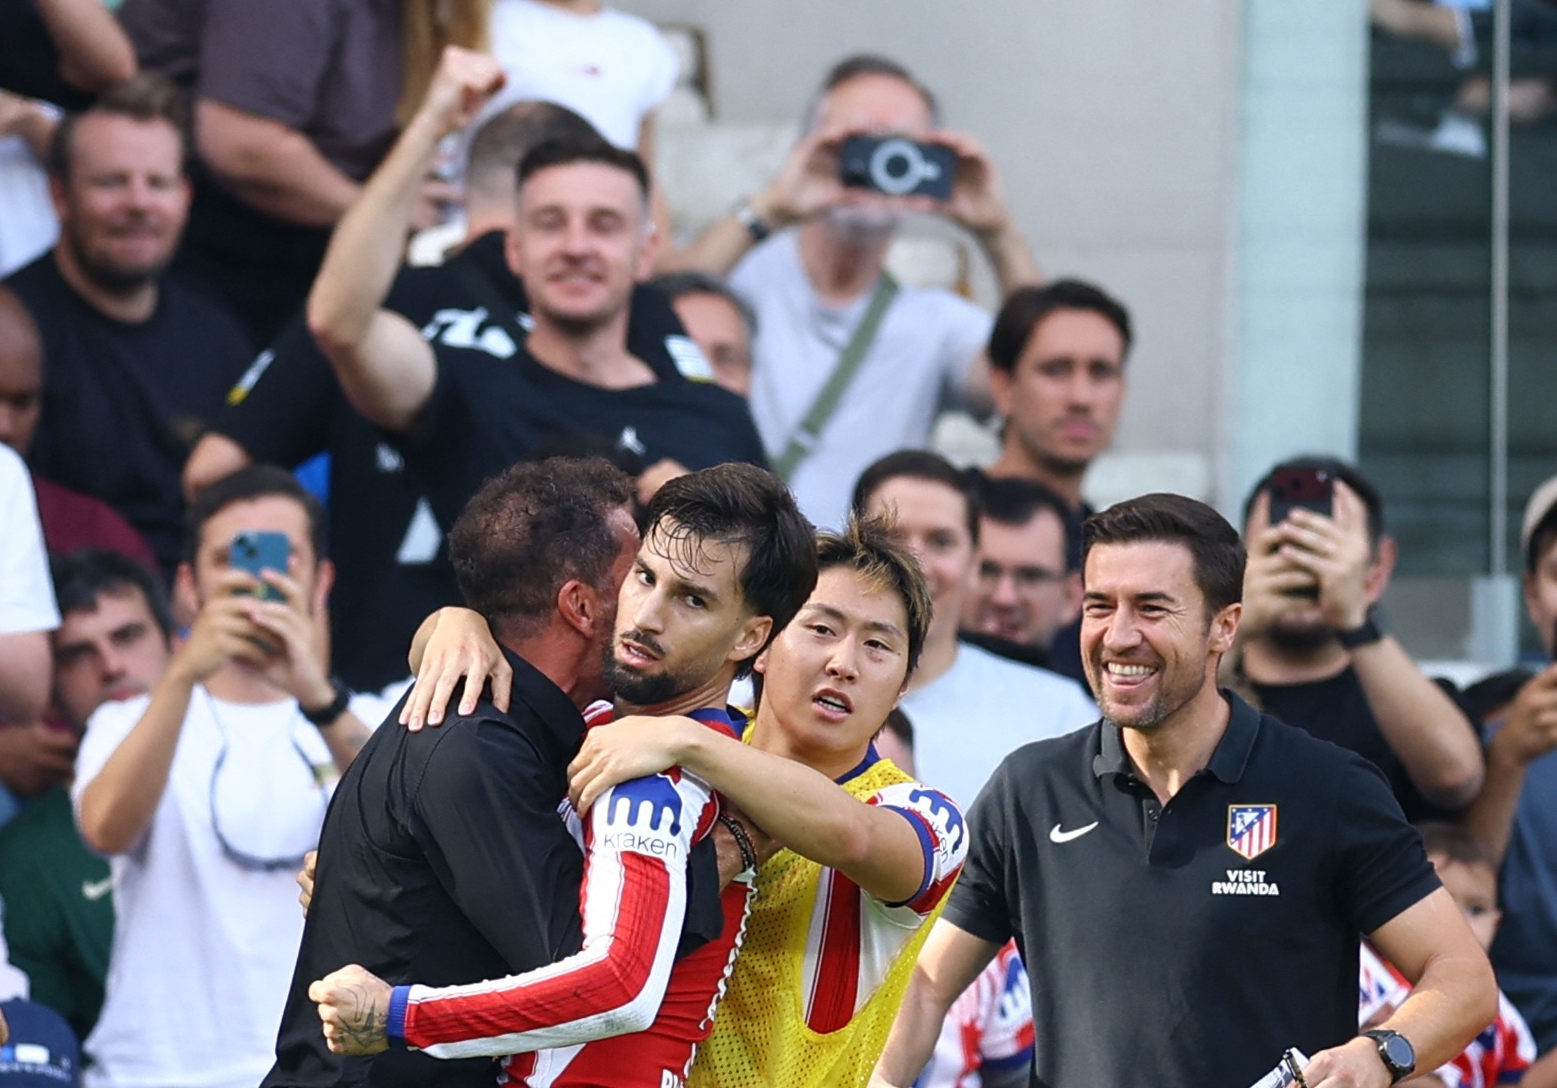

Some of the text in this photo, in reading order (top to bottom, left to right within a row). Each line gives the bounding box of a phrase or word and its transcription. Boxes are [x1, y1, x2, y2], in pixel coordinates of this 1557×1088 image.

[604, 830, 677, 860] kraken
[1226, 869, 1266, 883] VISIT
[1211, 881, 1280, 896] RWANDA
